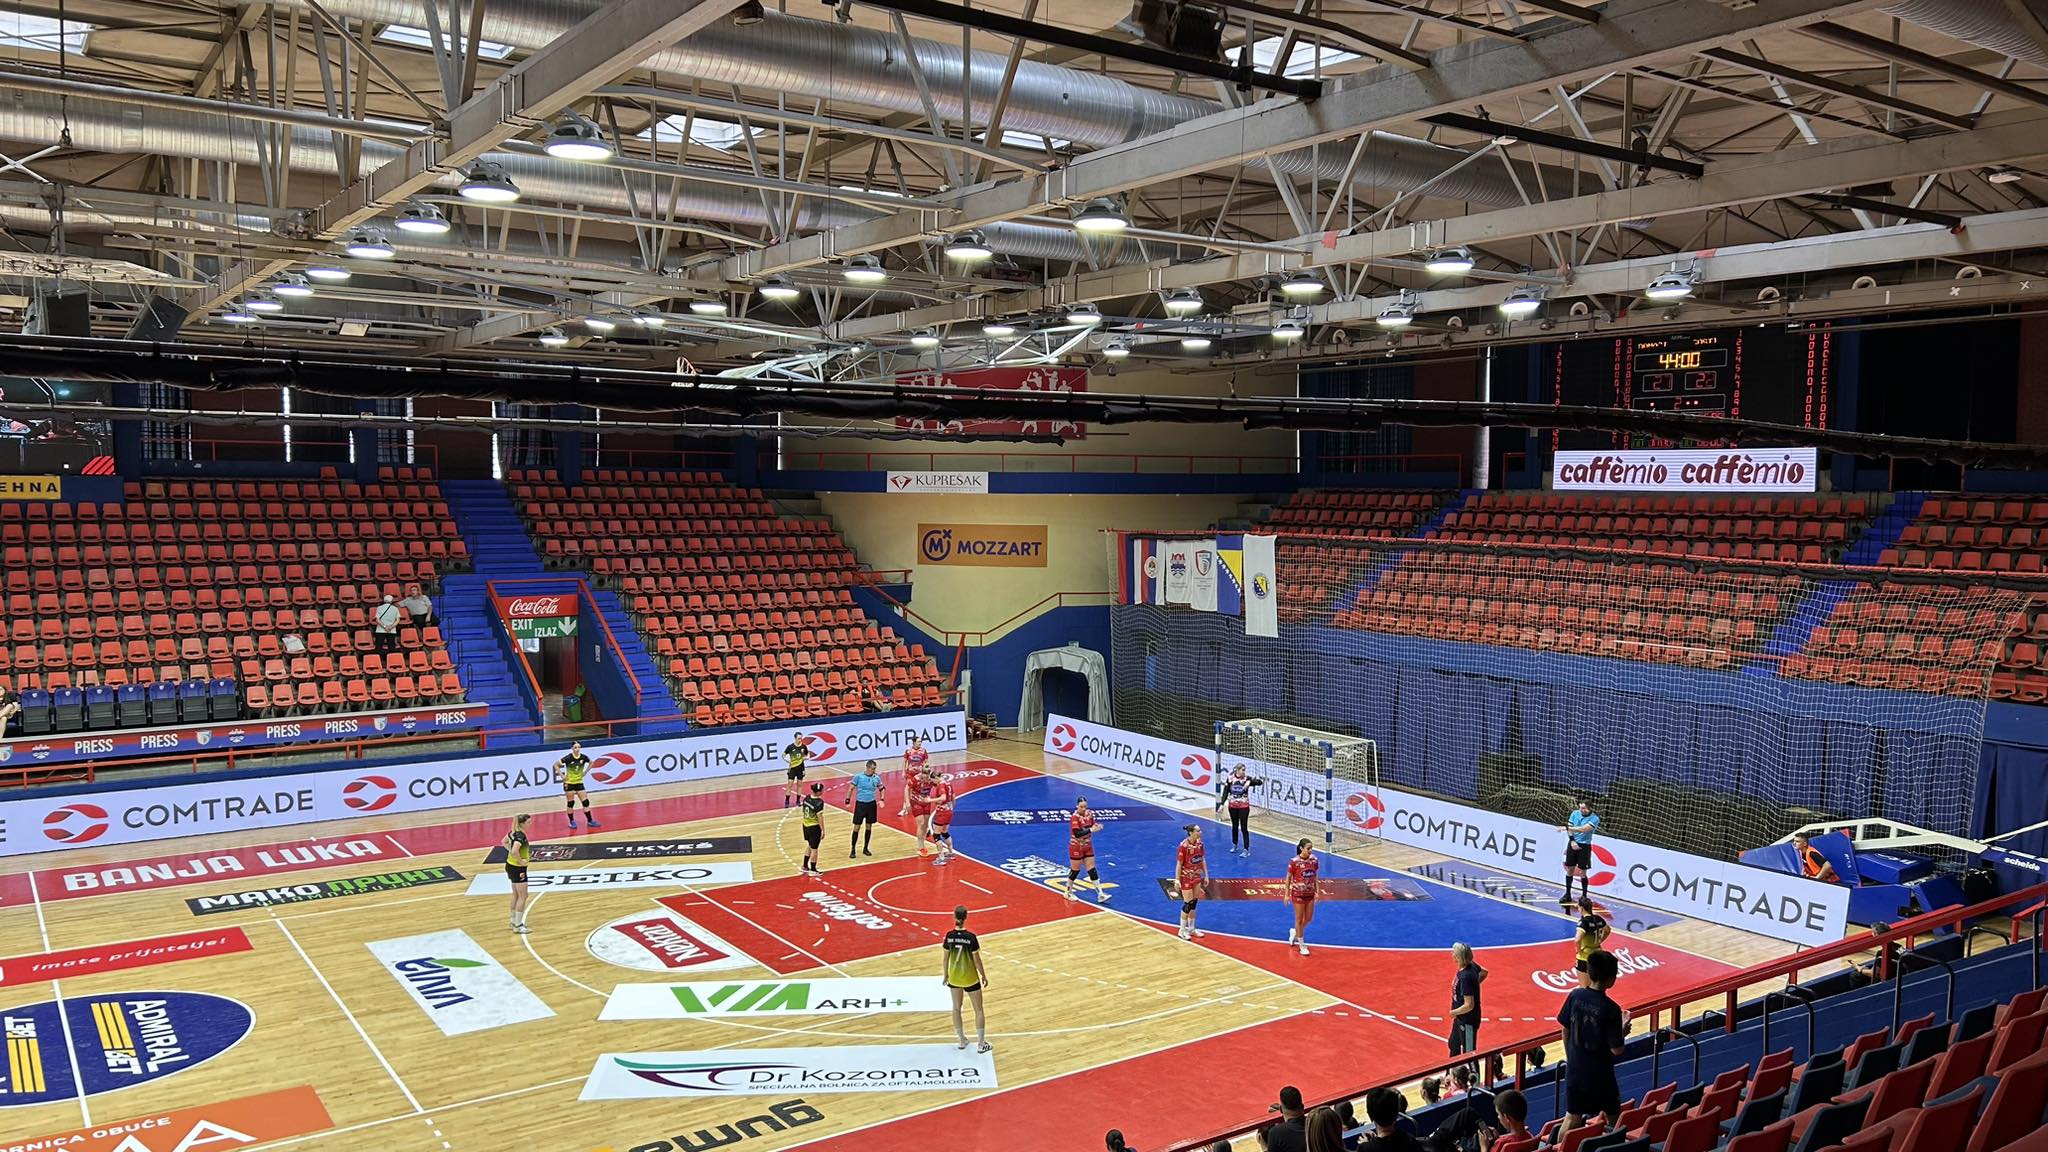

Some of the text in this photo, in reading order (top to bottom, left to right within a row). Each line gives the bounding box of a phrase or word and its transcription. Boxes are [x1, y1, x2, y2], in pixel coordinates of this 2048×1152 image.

[1659, 351, 1700, 369] 44:00
[916, 473, 982, 486] KUPREŠAK
[957, 541, 1043, 556] MOZZART
[512, 619, 534, 631] EXIT
[534, 627, 558, 637] IZLAZ
[75, 712, 467, 755] PRESS PRESS PRESS PRESS PRESS
[844, 724, 958, 752] COMTRADE
[645, 742, 779, 773] COMTRADE
[1081, 734, 1166, 771] COMTRADE
[408, 765, 564, 799] COMTRADE
[122, 788, 314, 829] COMTRADE
[1393, 808, 1537, 863] COMTRADE
[63, 839, 383, 891] BANJA LUKA
[527, 868, 713, 887] SEIKO
[1628, 863, 1828, 932] COMTRADE
[32, 937, 228, 972] imate prijatelje!
[634, 924, 709, 963] Nektar
[955, 945, 963, 961] 7
[125, 999, 190, 1073] ADMIRAL
[747, 1083, 818, 1091] SPECIJALNA
[818, 1082, 869, 1090] BOLNICA
[749, 1067, 981, 1084] Dr Kozomara
[91, 1116, 173, 1139] OBUĆE
